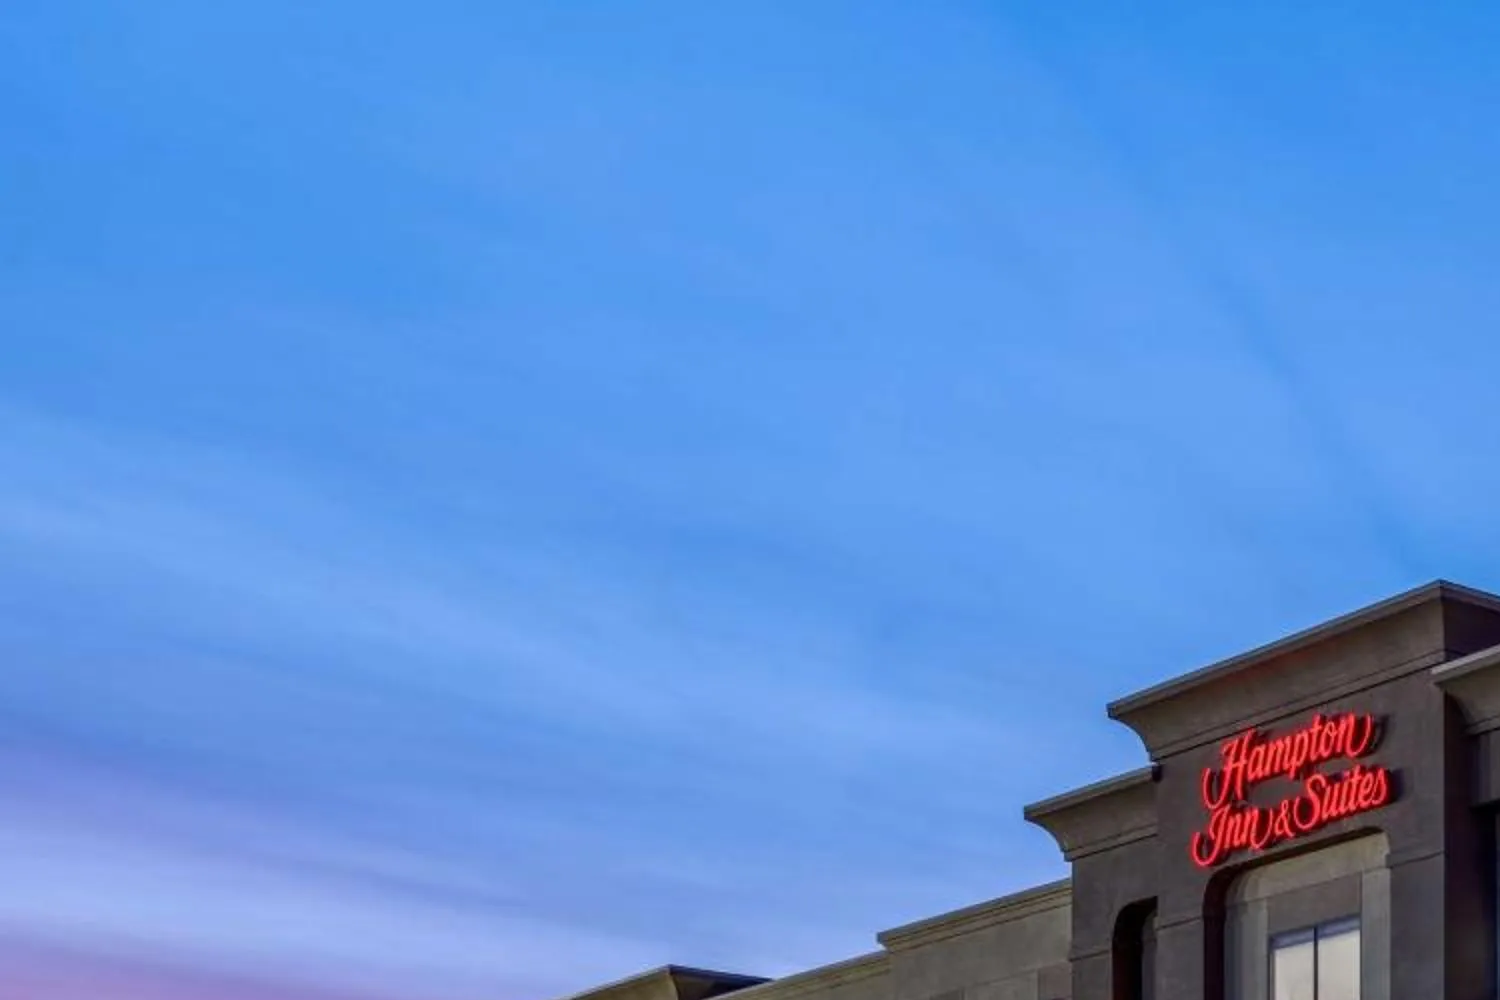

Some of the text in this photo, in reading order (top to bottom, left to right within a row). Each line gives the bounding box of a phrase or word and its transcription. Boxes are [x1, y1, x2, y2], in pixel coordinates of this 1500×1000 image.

[1202, 712, 1374, 809] Hampton
[1191, 764, 1389, 867] Inn & Suites
